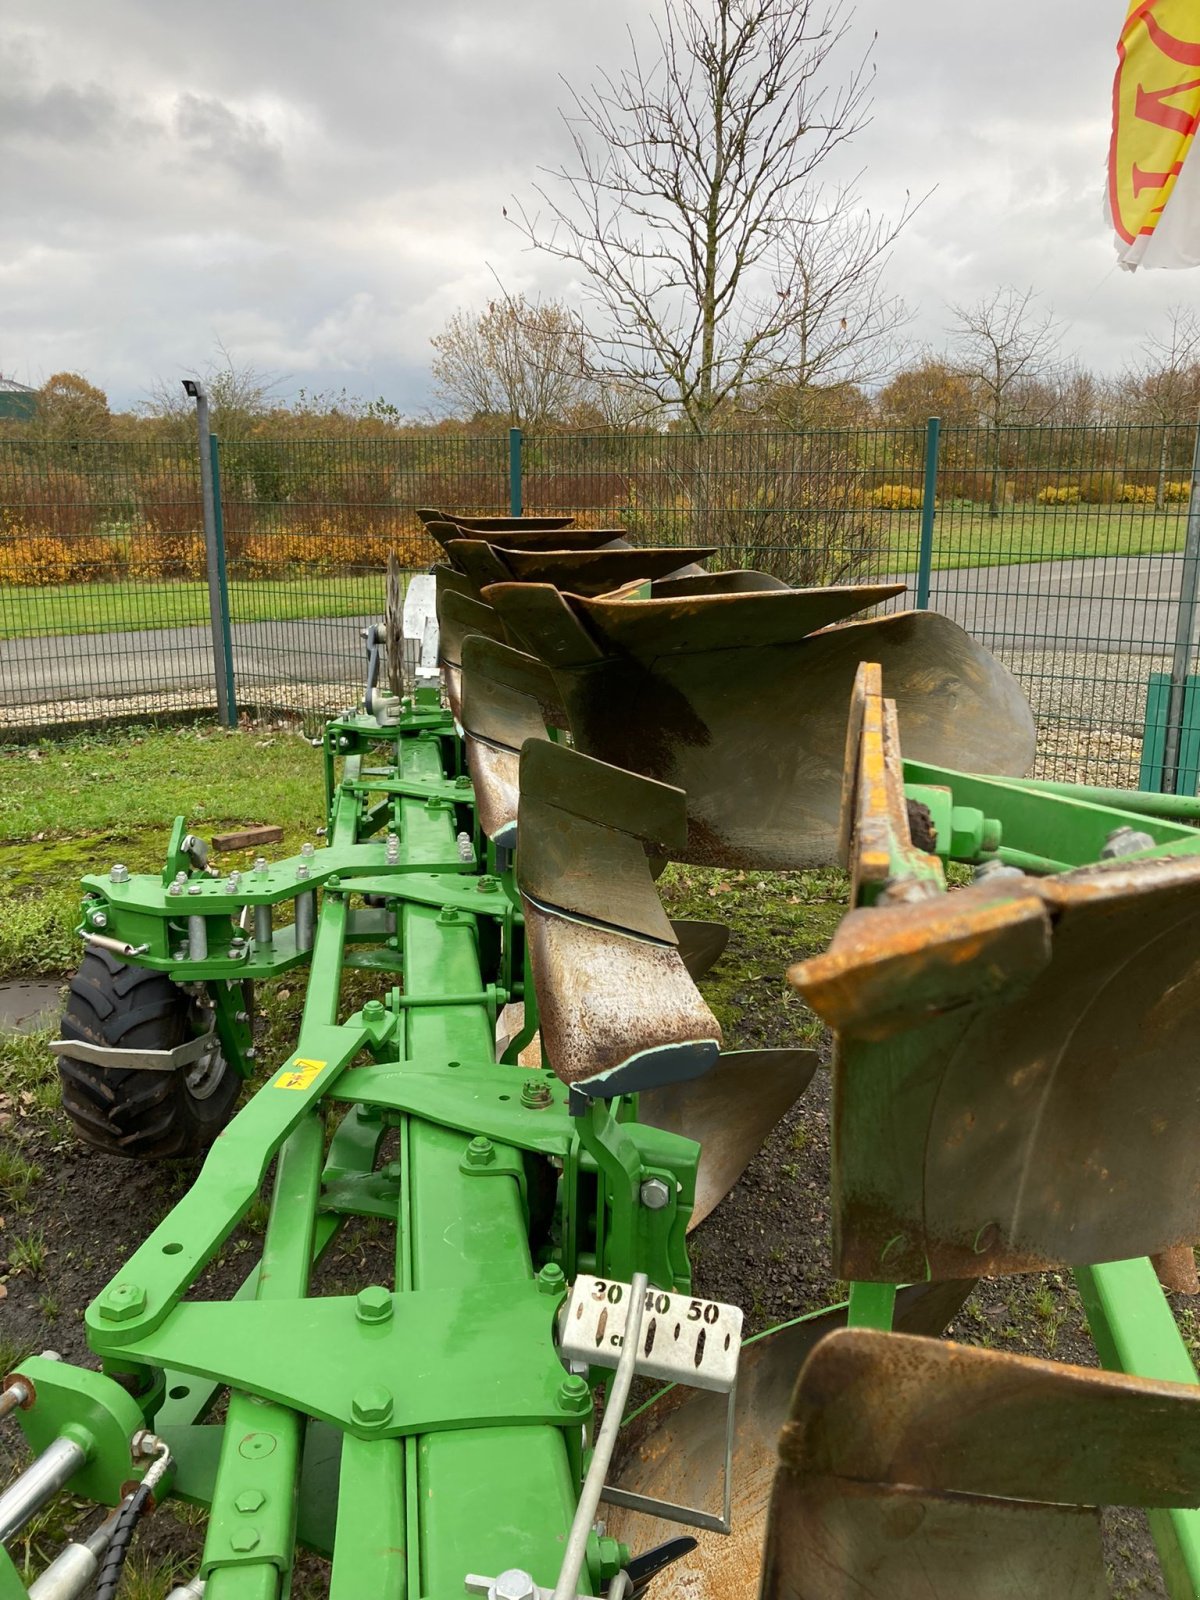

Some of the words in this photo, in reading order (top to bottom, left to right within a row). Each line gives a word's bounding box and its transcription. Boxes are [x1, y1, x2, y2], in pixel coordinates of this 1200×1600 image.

[592, 1281, 622, 1304] 30
[644, 1292, 670, 1315] 40
[687, 1300, 719, 1325] 50
[610, 1335, 623, 1347] c
